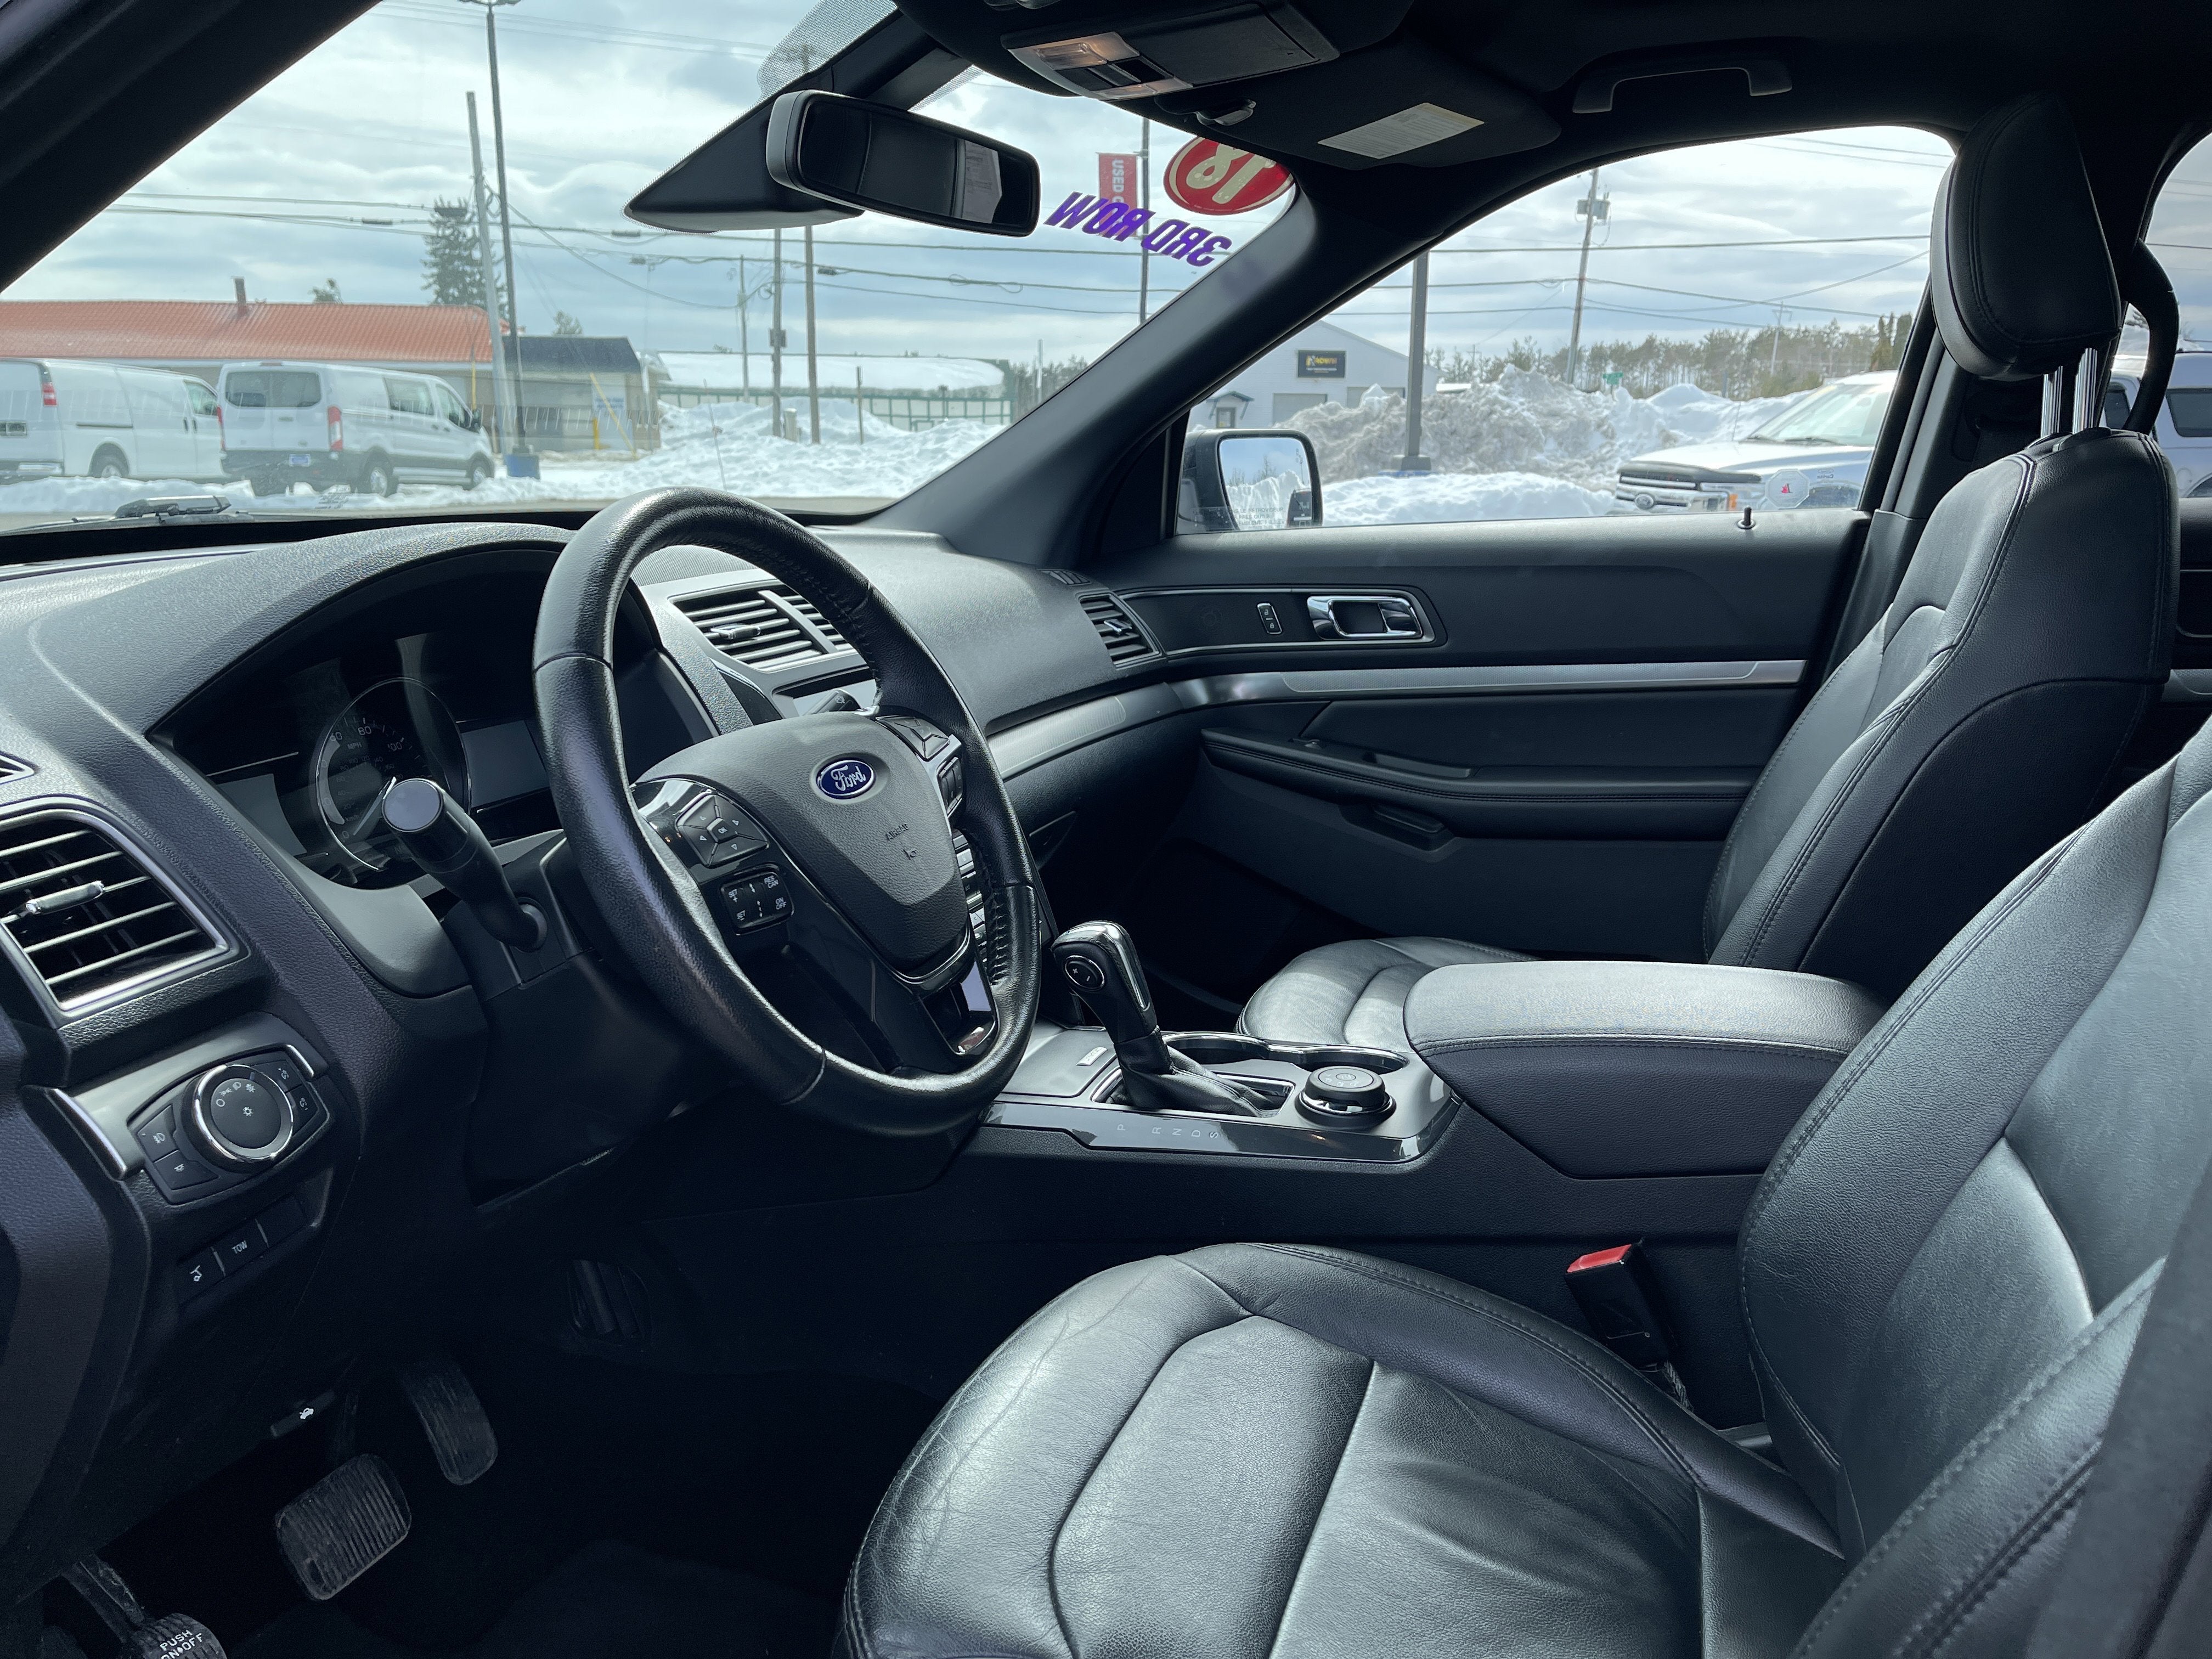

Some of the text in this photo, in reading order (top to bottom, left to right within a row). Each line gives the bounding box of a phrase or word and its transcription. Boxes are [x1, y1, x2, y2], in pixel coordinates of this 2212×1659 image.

[1111, 159, 1124, 193] USED
[358, 725, 372, 736] 80
[347, 742, 362, 751] MPH
[831, 765, 866, 791] Ford
[885, 823, 909, 841] AIRBAG
[764, 875, 775, 884] RES
[768, 879, 779, 889] CAN
[728, 888, 738, 898] SET
[776, 901, 787, 910] OFF
[736, 910, 746, 919] SET
[1152, 1126, 1162, 1135] R
[232, 1240, 247, 1254] TOW
[160, 1630, 193, 1651] PUSH
[182, 1633, 202, 1650] OFF
